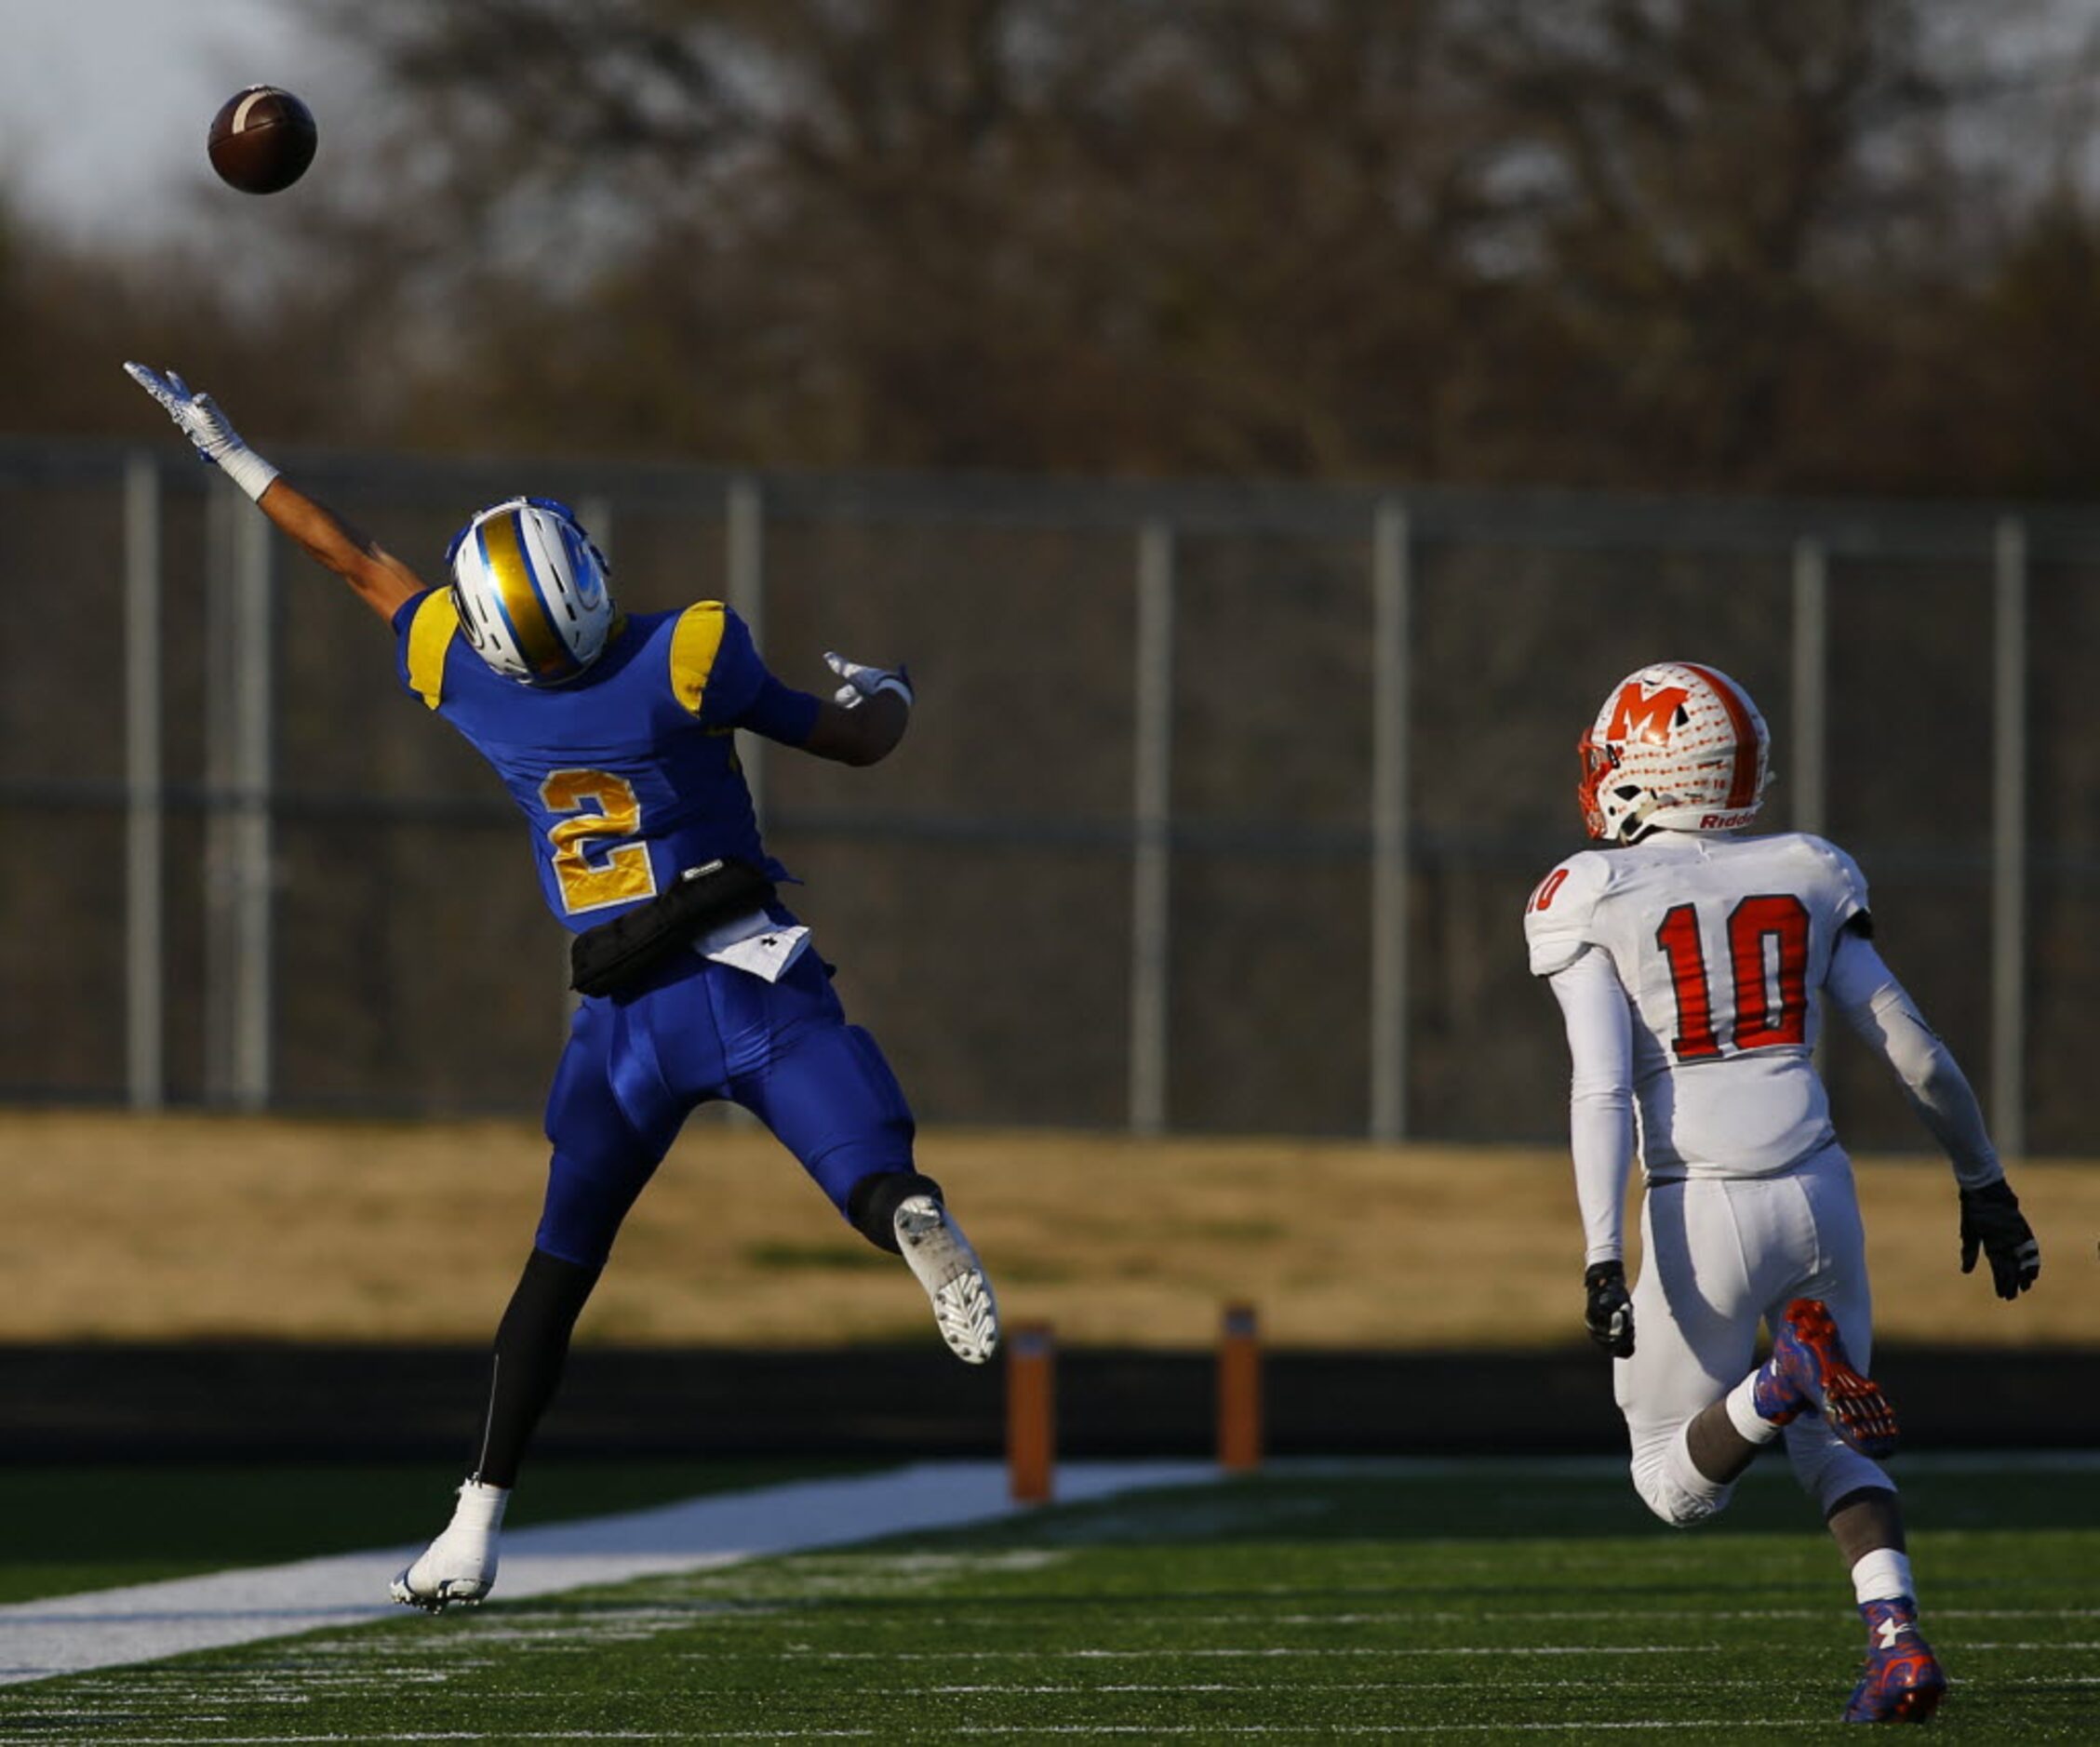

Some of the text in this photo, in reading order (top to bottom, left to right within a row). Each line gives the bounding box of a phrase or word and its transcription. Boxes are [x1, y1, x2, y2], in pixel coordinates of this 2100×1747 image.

[1607, 682, 1690, 748] M
[539, 769, 657, 914] 2
[1654, 893, 1811, 1062] 10
